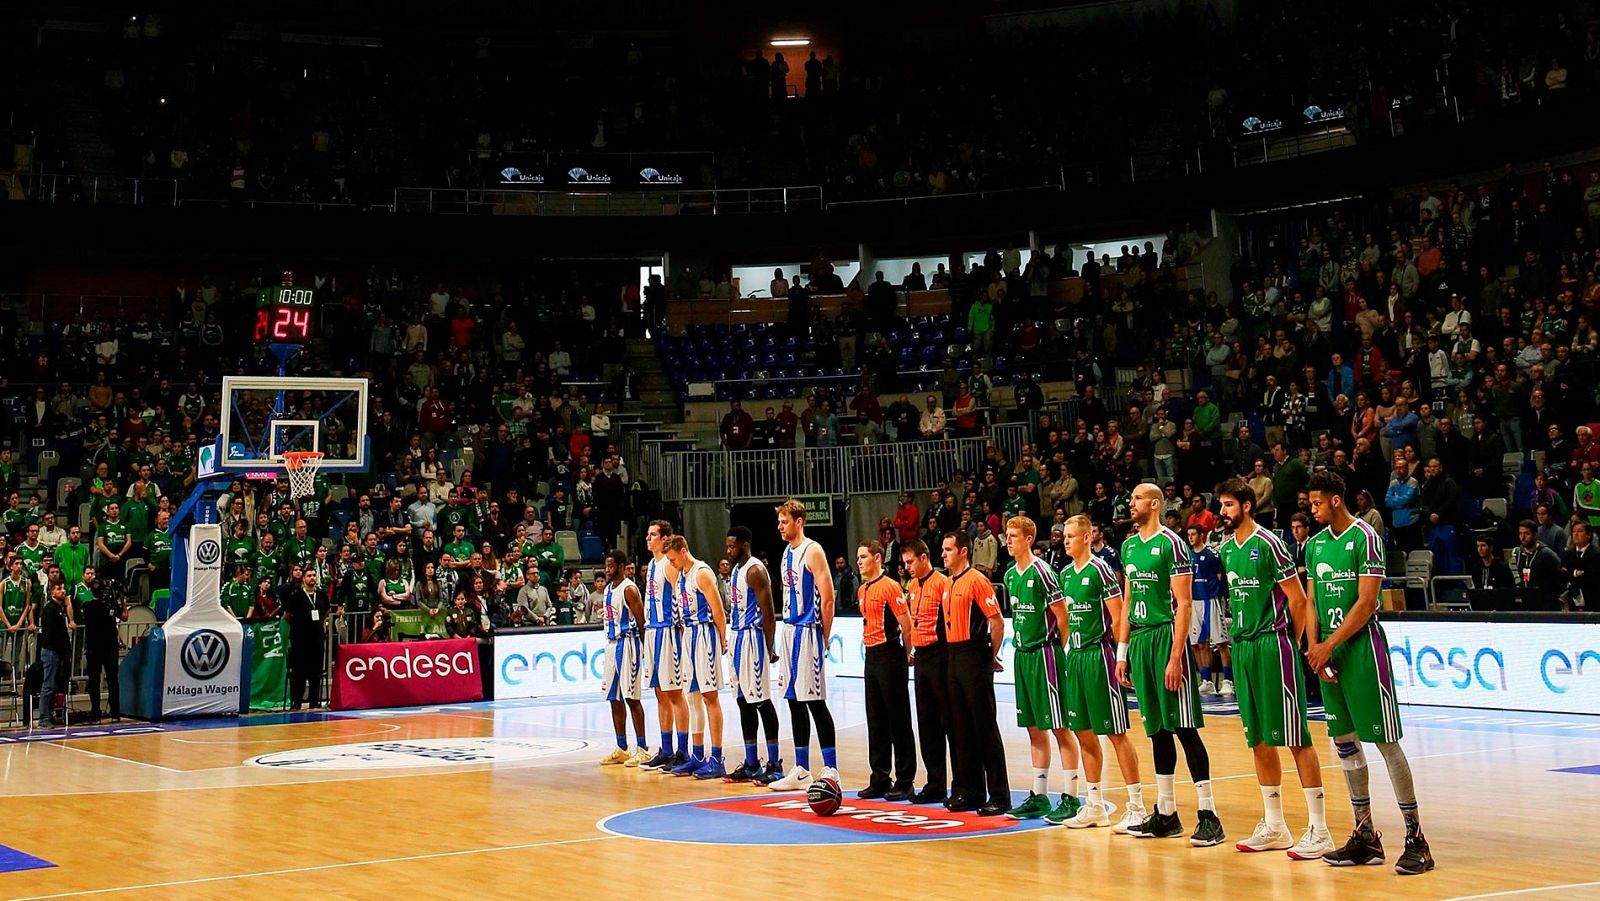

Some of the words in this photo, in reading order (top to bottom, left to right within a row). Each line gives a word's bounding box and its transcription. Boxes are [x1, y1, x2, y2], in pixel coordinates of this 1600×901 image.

[519, 173, 545, 182] Unicaja
[586, 173, 611, 182] Unicaja
[657, 173, 682, 182] Unicaja
[279, 289, 313, 305] 10:00
[274, 309, 309, 338] 24
[819, 501, 827, 510] DE
[1135, 570, 1159, 580] Unicaja
[1194, 564, 1199, 573] 7
[1331, 569, 1356, 579] Unicaja
[1134, 601, 1147, 619] 40
[1327, 607, 1345, 629] 23
[1237, 610, 1244, 629] 1
[1015, 631, 1022, 648] 9
[1071, 631, 1081, 649] 10
[346, 648, 474, 681] endesa
[1389, 635, 1507, 692] desa
[167, 685, 203, 697] Málaga
[205, 685, 239, 696] Wagen
